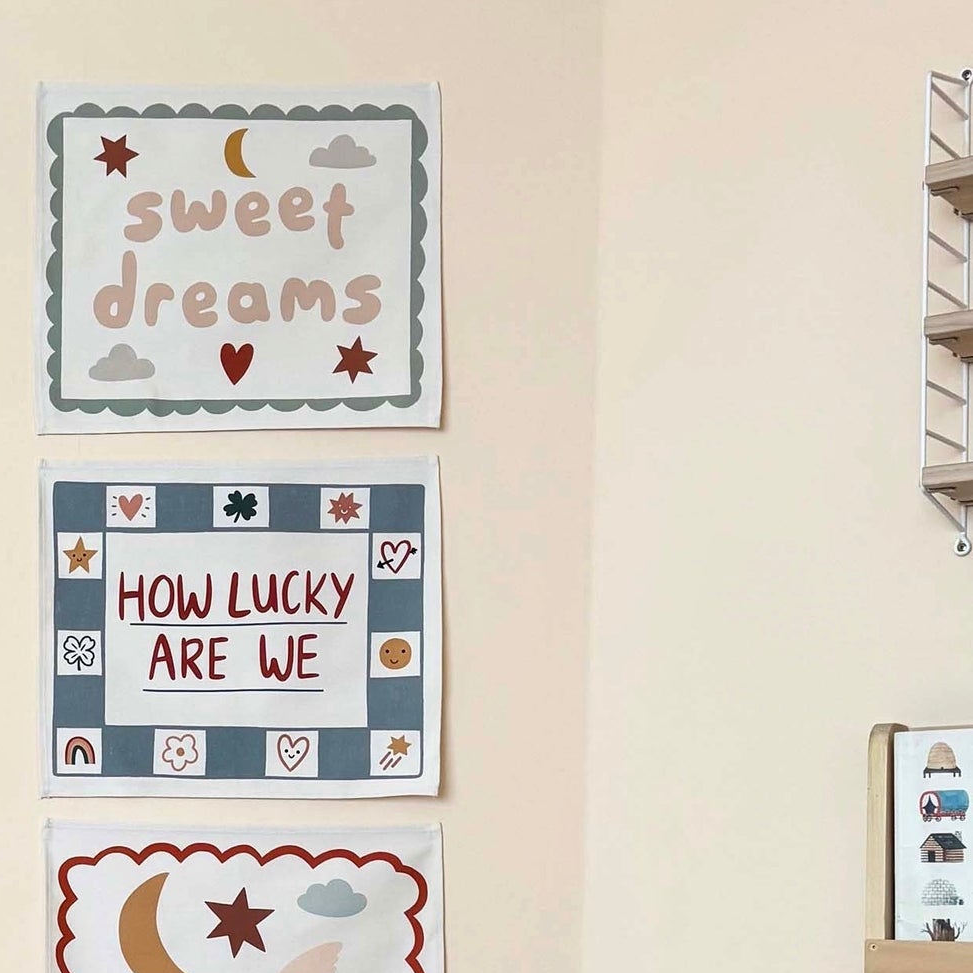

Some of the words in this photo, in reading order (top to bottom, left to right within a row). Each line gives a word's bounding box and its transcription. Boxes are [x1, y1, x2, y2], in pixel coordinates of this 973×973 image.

[123, 182, 355, 250] sweet
[93, 249, 382, 329] dreams
[118, 571, 213, 621] HOW
[228, 570, 355, 619] LUCKY
[148, 633, 229, 681] ARE
[259, 633, 320, 682] WE
